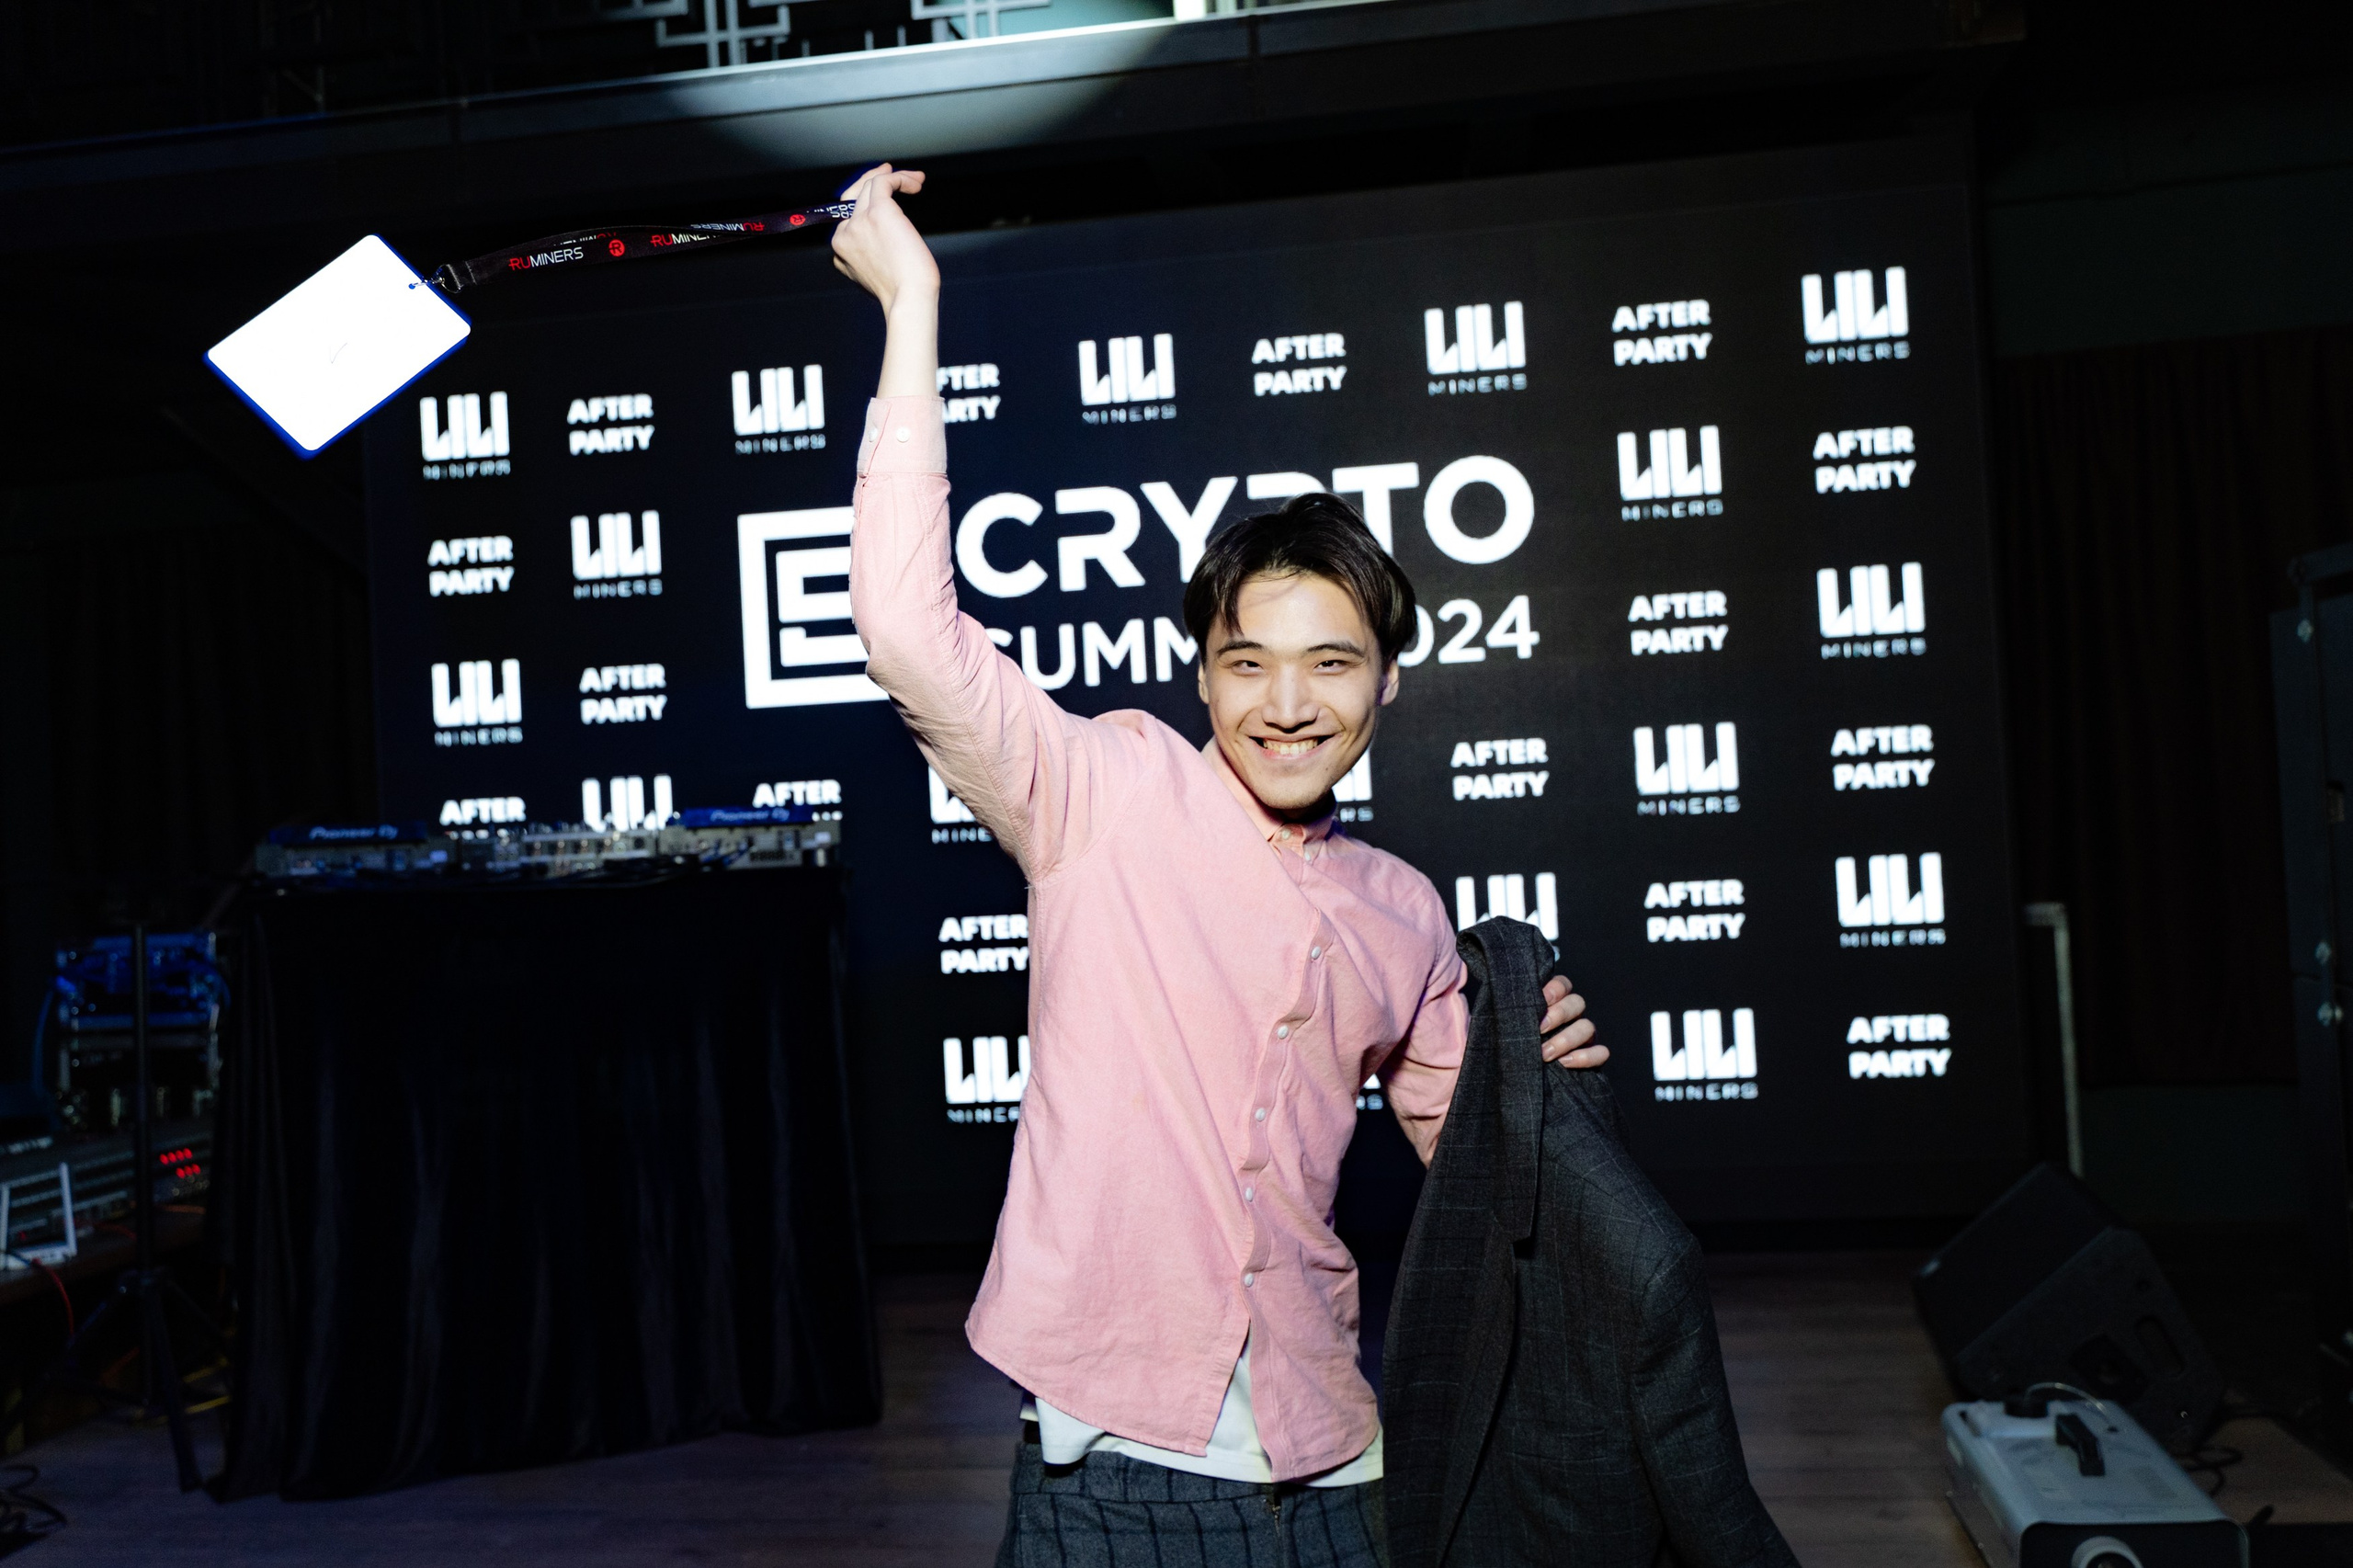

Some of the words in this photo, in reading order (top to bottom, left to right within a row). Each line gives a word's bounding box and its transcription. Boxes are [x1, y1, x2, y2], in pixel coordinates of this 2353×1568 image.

[508, 246, 584, 271] RUMINERS
[1612, 300, 1711, 332] AFTER
[1252, 333, 1346, 364] AFTER
[1614, 333, 1712, 366] PARTY
[1805, 342, 1910, 364] MINERS
[936, 363, 1000, 392] FTER
[1254, 366, 1347, 396] PARTY
[1427, 374, 1528, 397] MINERS
[567, 394, 654, 424] AFTER
[1082, 405, 1176, 425] MINERS
[570, 425, 654, 455] PARTY
[1813, 426, 1915, 460] AFTER
[1815, 460, 1915, 494] PARTY
[1621, 500, 1723, 521] MINERS
[428, 536, 513, 566] AFTER
[429, 566, 514, 597] PARTY
[574, 580, 663, 599] MINERS
[1628, 590, 1727, 622] AFTER
[1397, 595, 1540, 667] 024
[1631, 625, 1728, 655] PARTY
[1821, 637, 1927, 660] MINERS
[579, 664, 665, 693] AFTER
[581, 695, 667, 724] PARTY
[1450, 738, 1549, 767] AFTER
[1831, 725, 1933, 756] AFTER
[1452, 771, 1549, 801] PARTY
[1833, 759, 1935, 790] PARTY
[753, 779, 841, 808] AFTER
[1637, 795, 1741, 816] MINERS
[439, 797, 526, 825] AFTER
[931, 826, 993, 845] MINE
[1644, 880, 1745, 909] AFTER
[938, 914, 1029, 942] AFTER
[1647, 913, 1745, 942] PARTY
[940, 946, 1029, 974] PARTY
[1847, 1014, 1949, 1043] AFTER
[1848, 1049, 1951, 1079] PARTY
[1654, 1082, 1758, 1101] MINERS
